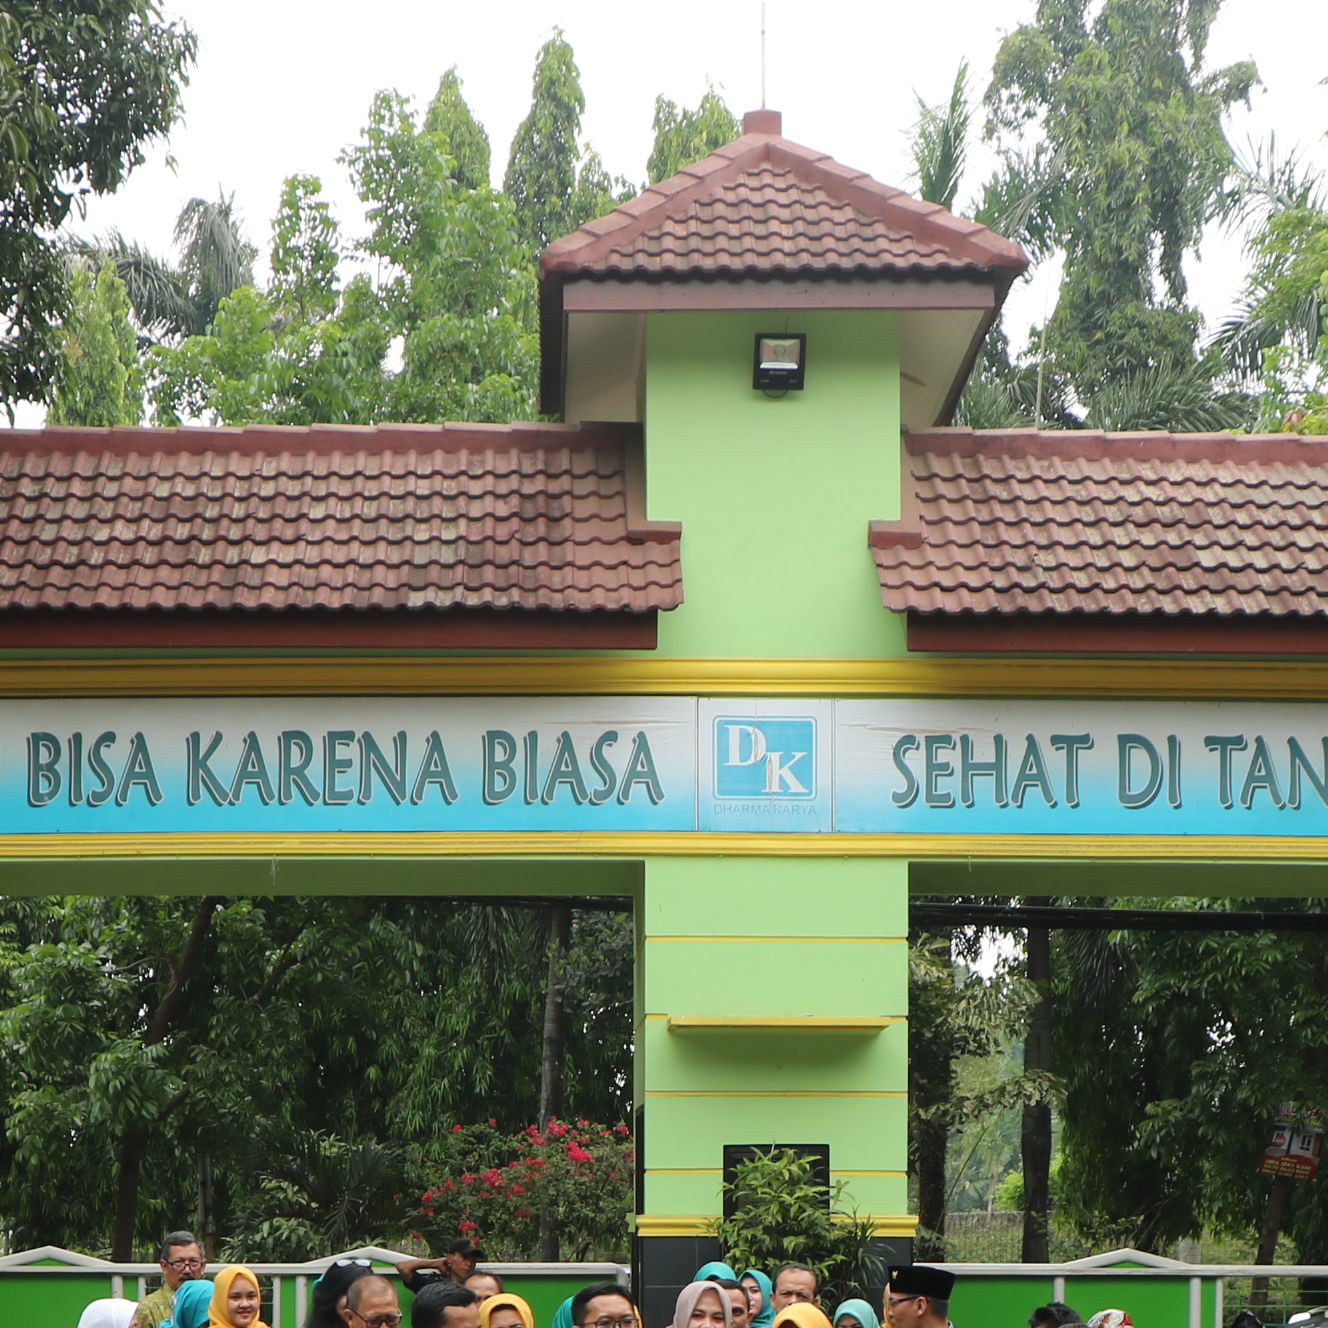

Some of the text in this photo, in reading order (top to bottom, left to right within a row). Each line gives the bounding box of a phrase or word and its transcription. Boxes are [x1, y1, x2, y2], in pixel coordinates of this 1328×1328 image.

[25, 730, 164, 808] BISA
[185, 729, 461, 808] KARENA
[481, 729, 666, 807] BIASA
[723, 724, 810, 793] DK
[890, 732, 1095, 809] SEHAT
[1116, 733, 1183, 810] DI
[713, 803, 817, 816] DHARMA KARYA
